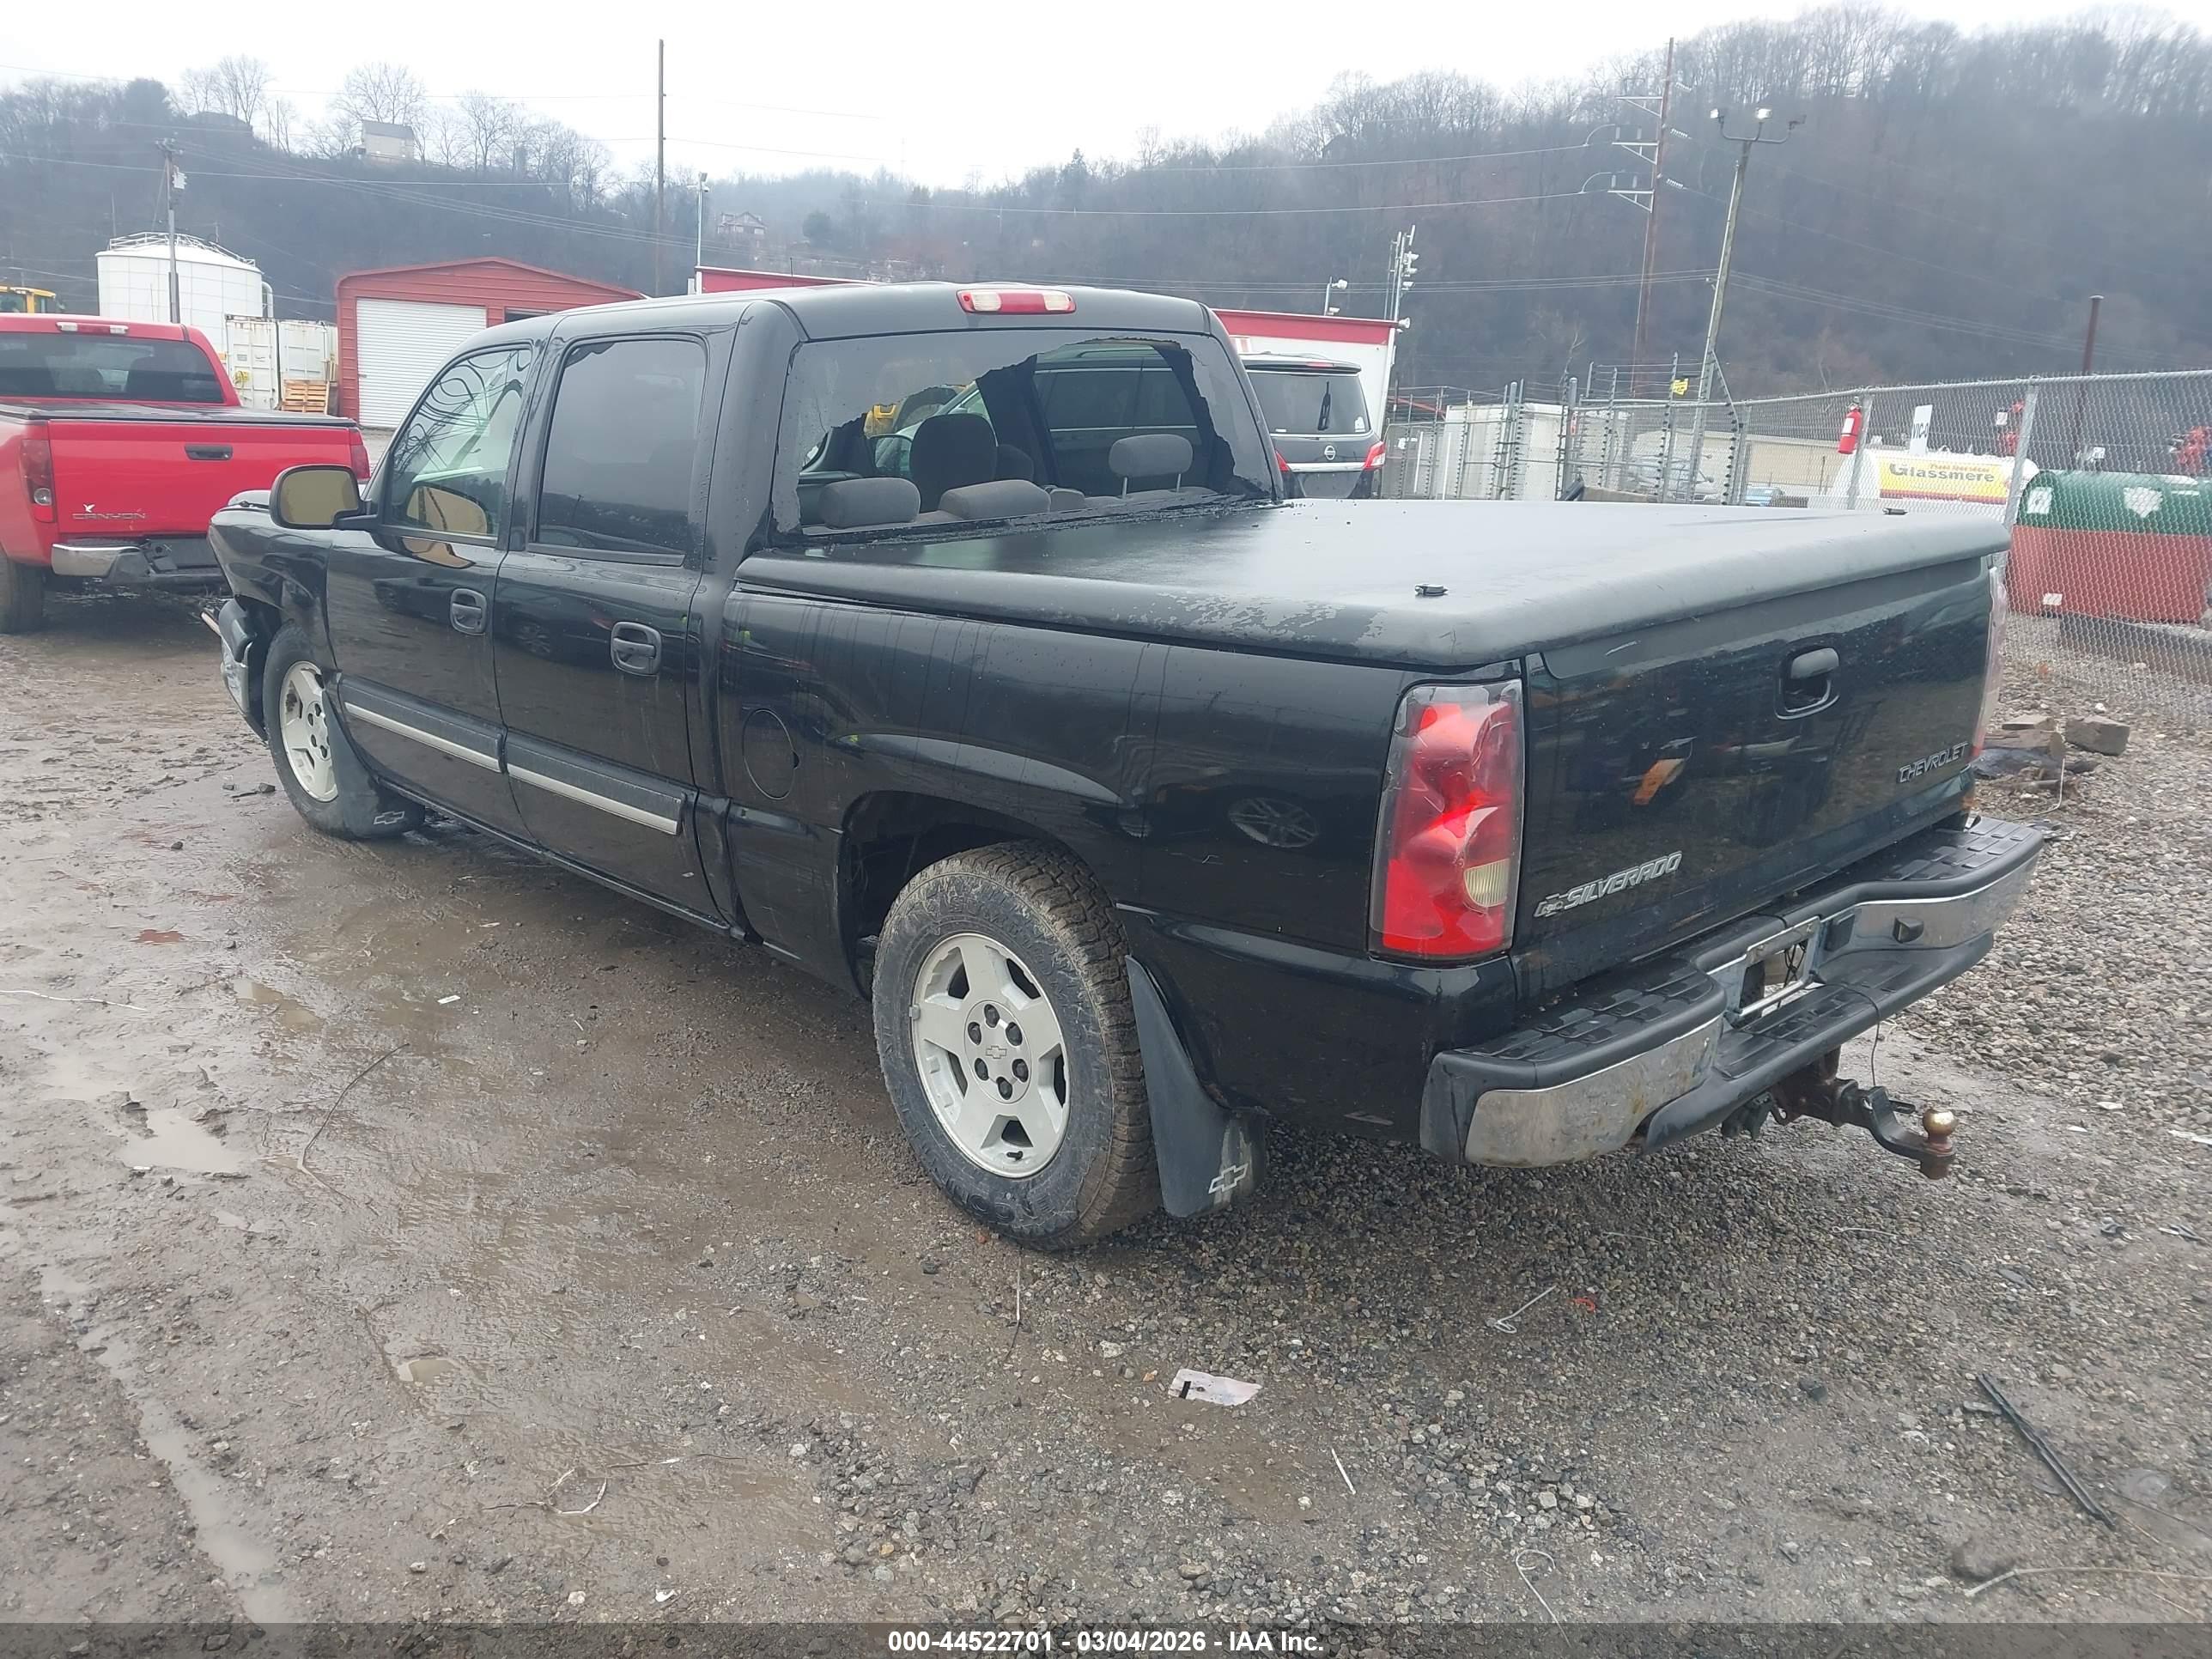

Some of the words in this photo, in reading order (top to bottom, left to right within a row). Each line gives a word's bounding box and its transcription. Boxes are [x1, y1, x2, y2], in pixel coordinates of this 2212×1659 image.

[1889, 463, 1995, 483] Glassmere
[1899, 741, 1969, 783] CHEVROLET
[1565, 851, 1682, 910] SILVERADO
